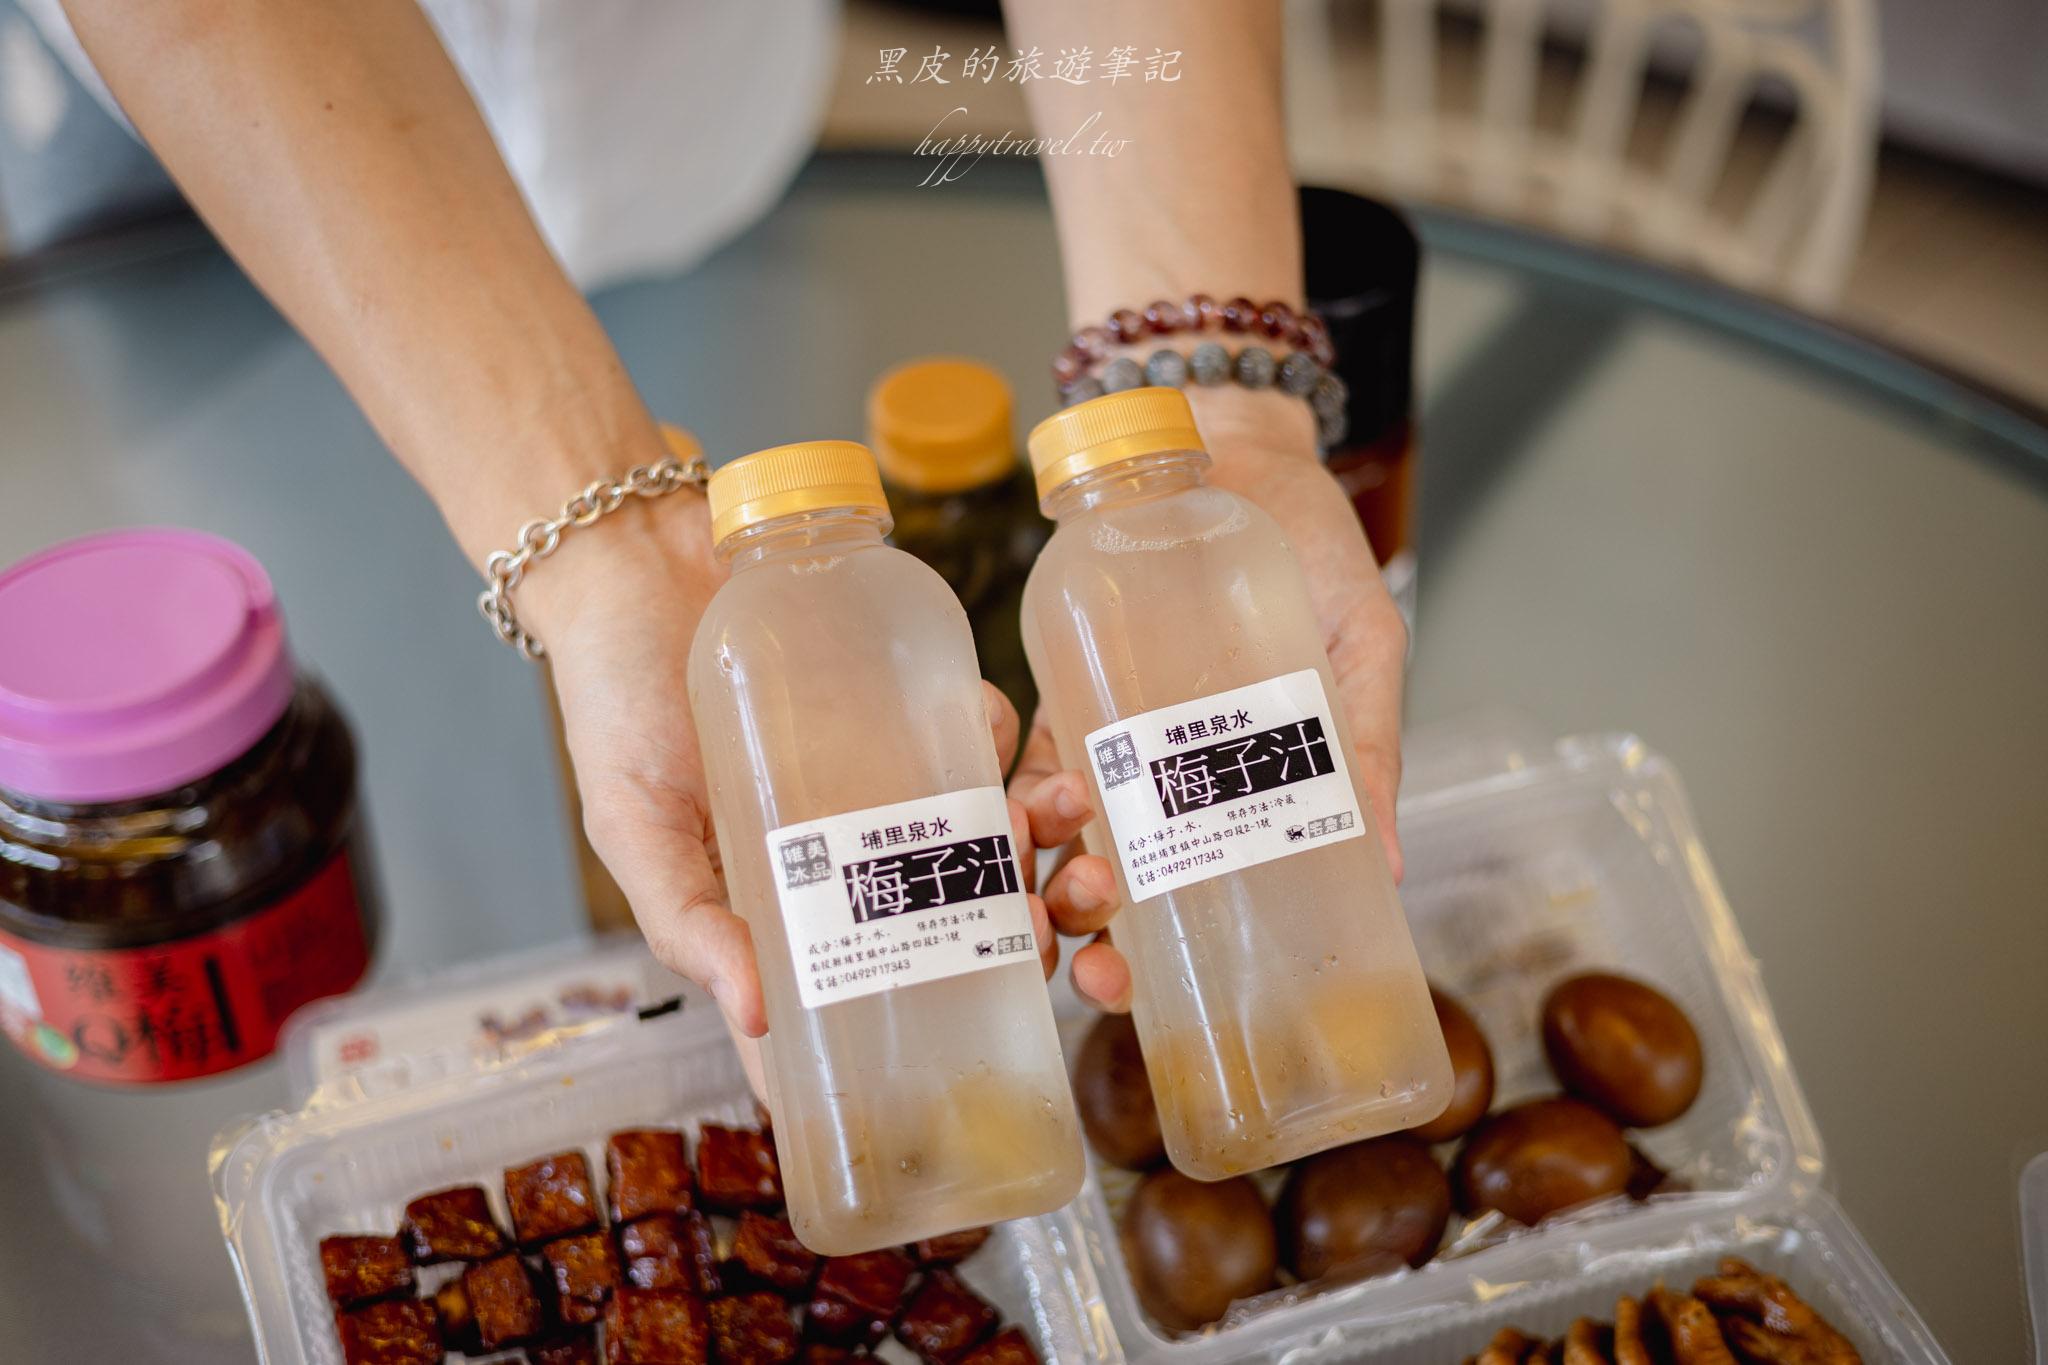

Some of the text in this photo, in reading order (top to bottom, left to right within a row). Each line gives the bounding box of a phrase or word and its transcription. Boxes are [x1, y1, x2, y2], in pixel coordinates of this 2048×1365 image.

[1165, 709, 1253, 746] 埔里泉水
[1154, 723, 1326, 815] 梅子汁
[860, 816, 952, 851] 埔里泉水
[846, 837, 1012, 921] 梅子汁
